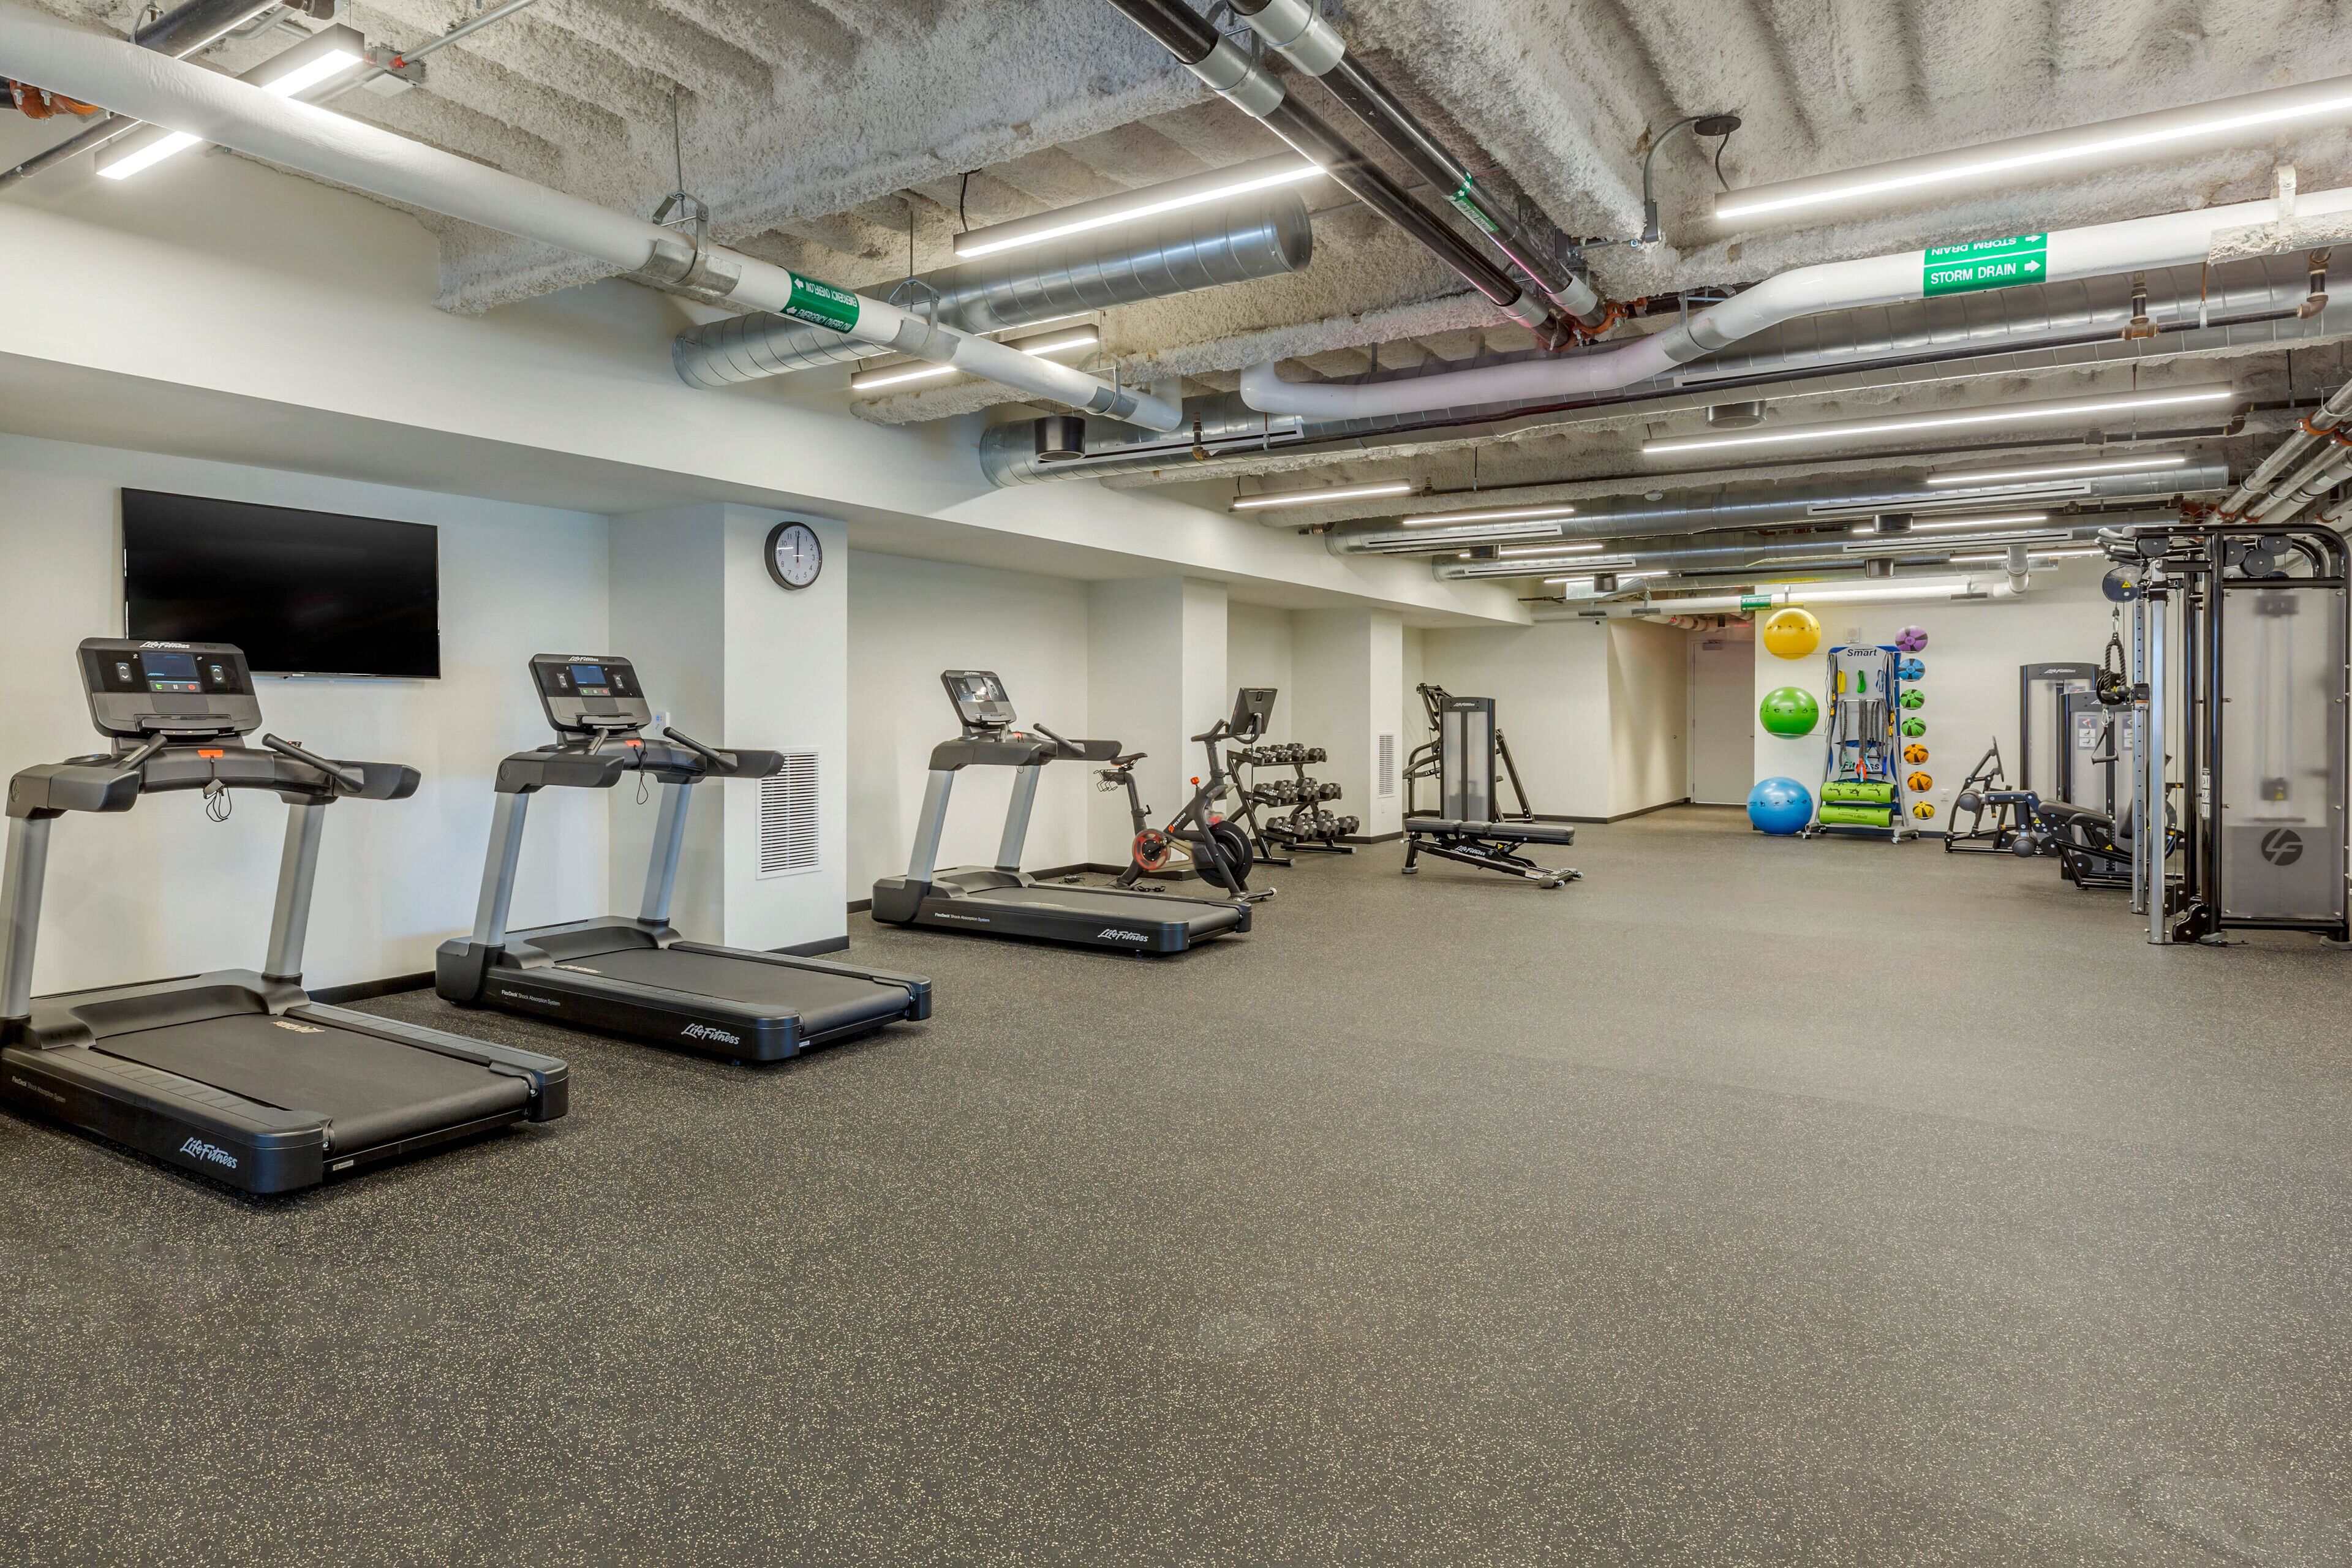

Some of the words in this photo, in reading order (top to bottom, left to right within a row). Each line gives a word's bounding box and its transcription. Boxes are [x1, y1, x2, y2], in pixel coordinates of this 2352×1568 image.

[1931, 244, 1969, 256] DRAIN
[1973, 238, 2017, 250] STORM
[1931, 268, 1973, 284] STORM
[1978, 263, 2016, 279] DRAIN
[805, 282, 831, 298] OVERFLOW
[831, 290, 857, 307] EMERGENCY
[796, 309, 828, 325] EMERGENCY
[824, 318, 853, 331] OVERFLOW
[1172, 812, 1186, 827] PELOTON
